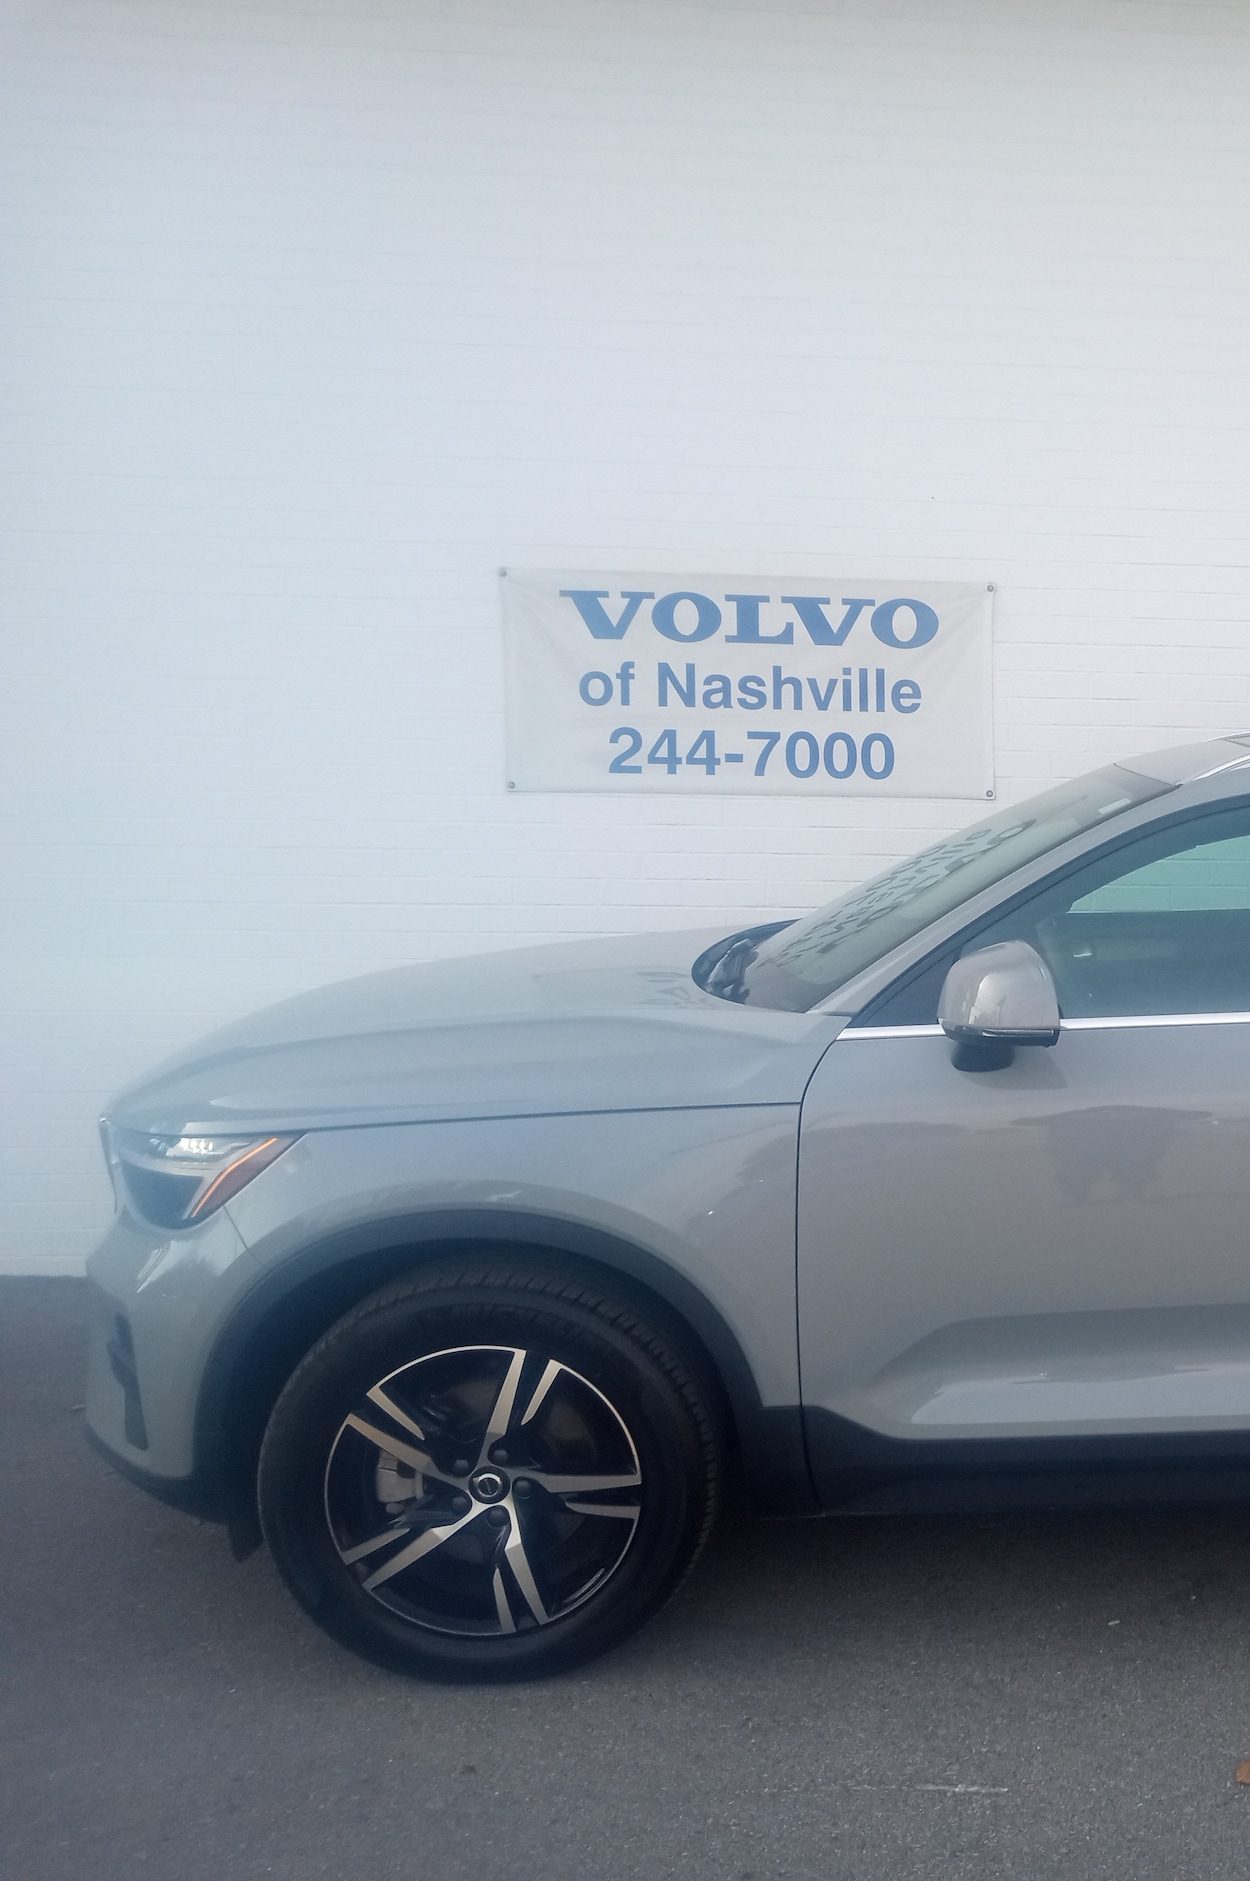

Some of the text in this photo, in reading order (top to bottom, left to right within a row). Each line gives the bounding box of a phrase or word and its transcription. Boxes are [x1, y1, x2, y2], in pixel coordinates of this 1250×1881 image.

[559, 590, 939, 649] VOLVO
[579, 662, 922, 714] of Nashville
[608, 727, 895, 780] 244-7000
